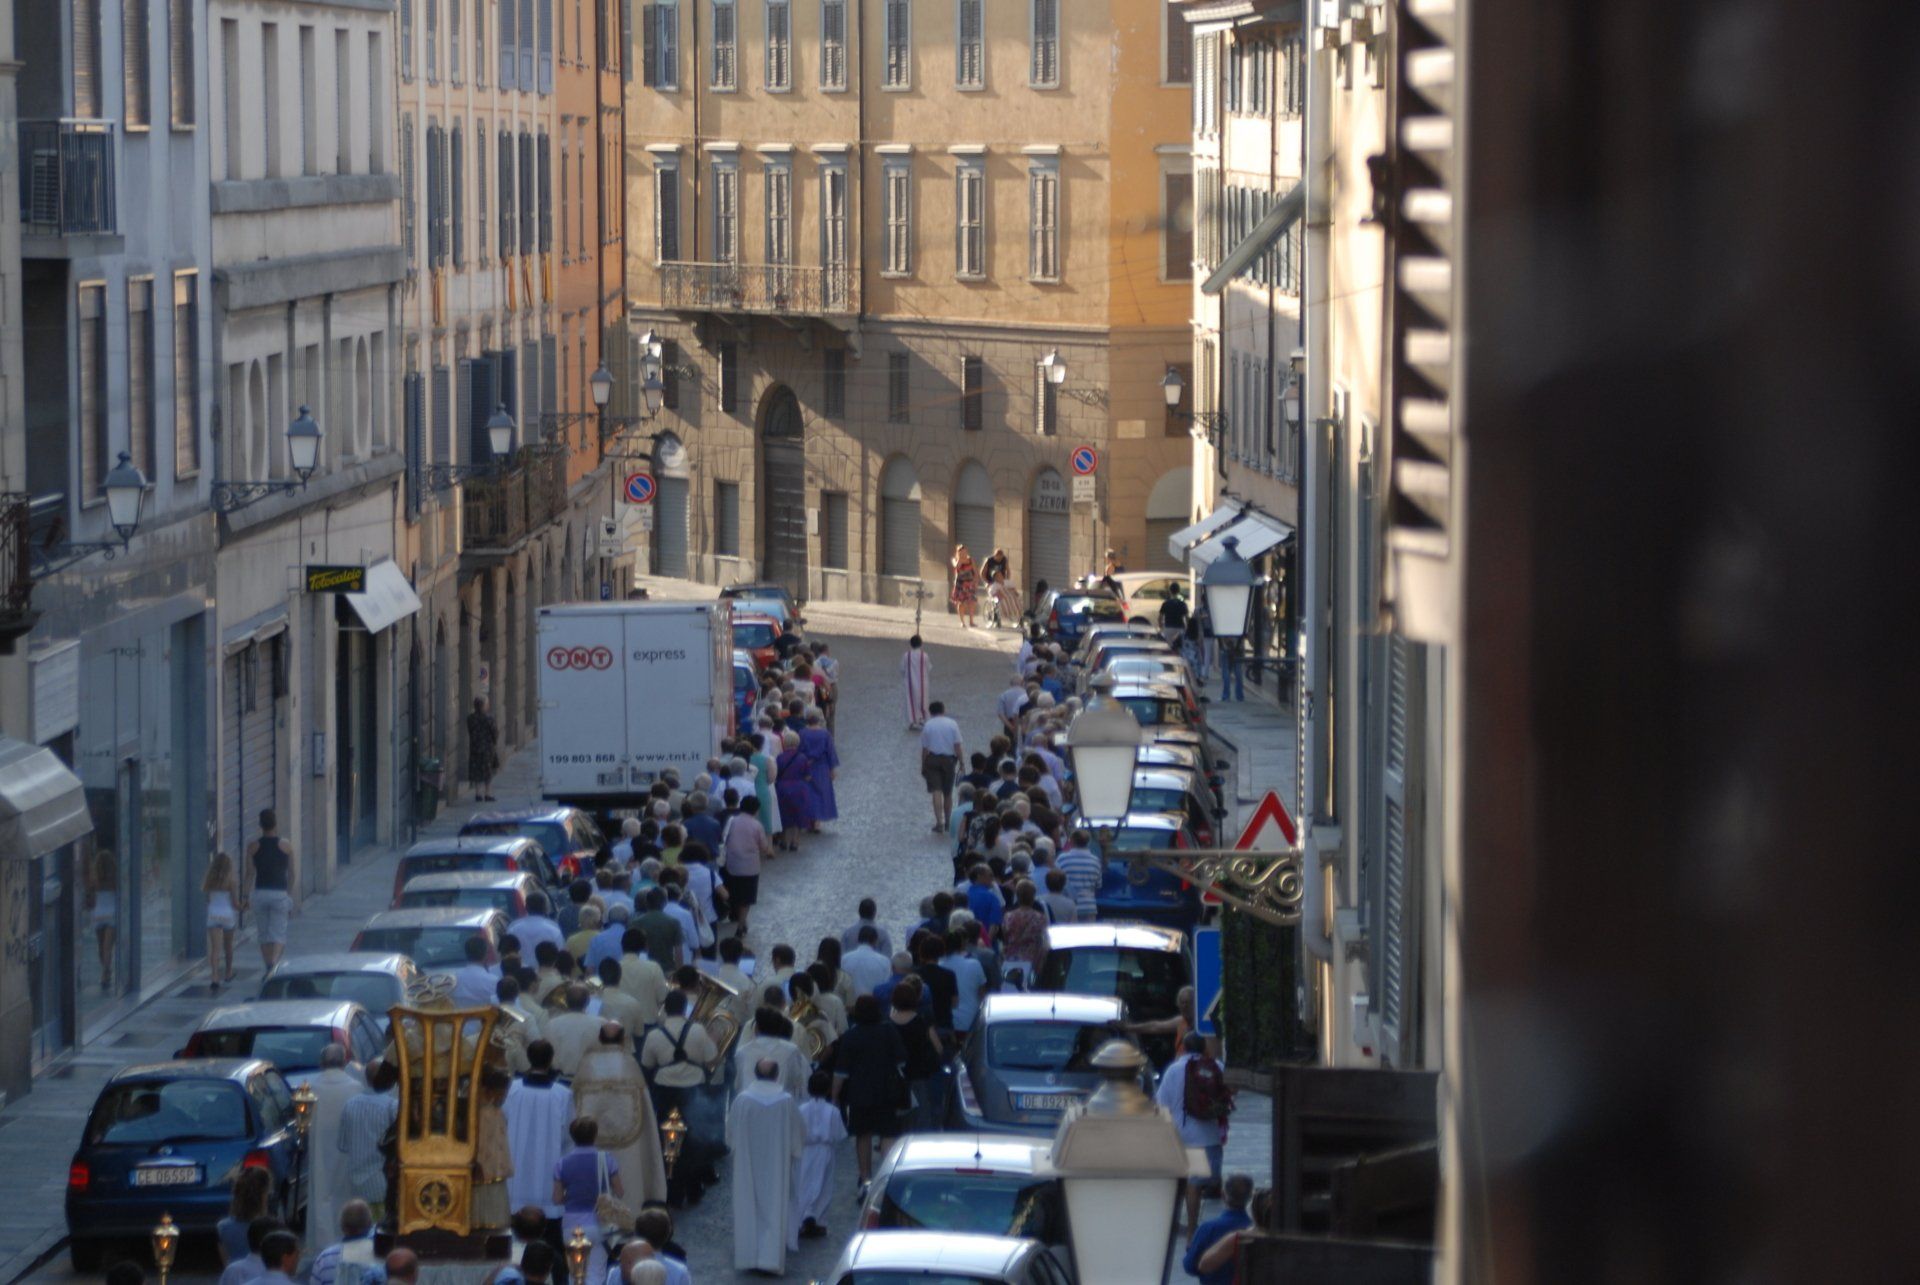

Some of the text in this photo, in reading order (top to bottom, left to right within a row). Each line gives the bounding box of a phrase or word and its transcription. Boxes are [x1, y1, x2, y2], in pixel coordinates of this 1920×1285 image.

[633, 649, 686, 663] express
[550, 754, 569, 764] 199
[571, 754, 592, 763] 803
[635, 751, 700, 762] www.tnt.it
